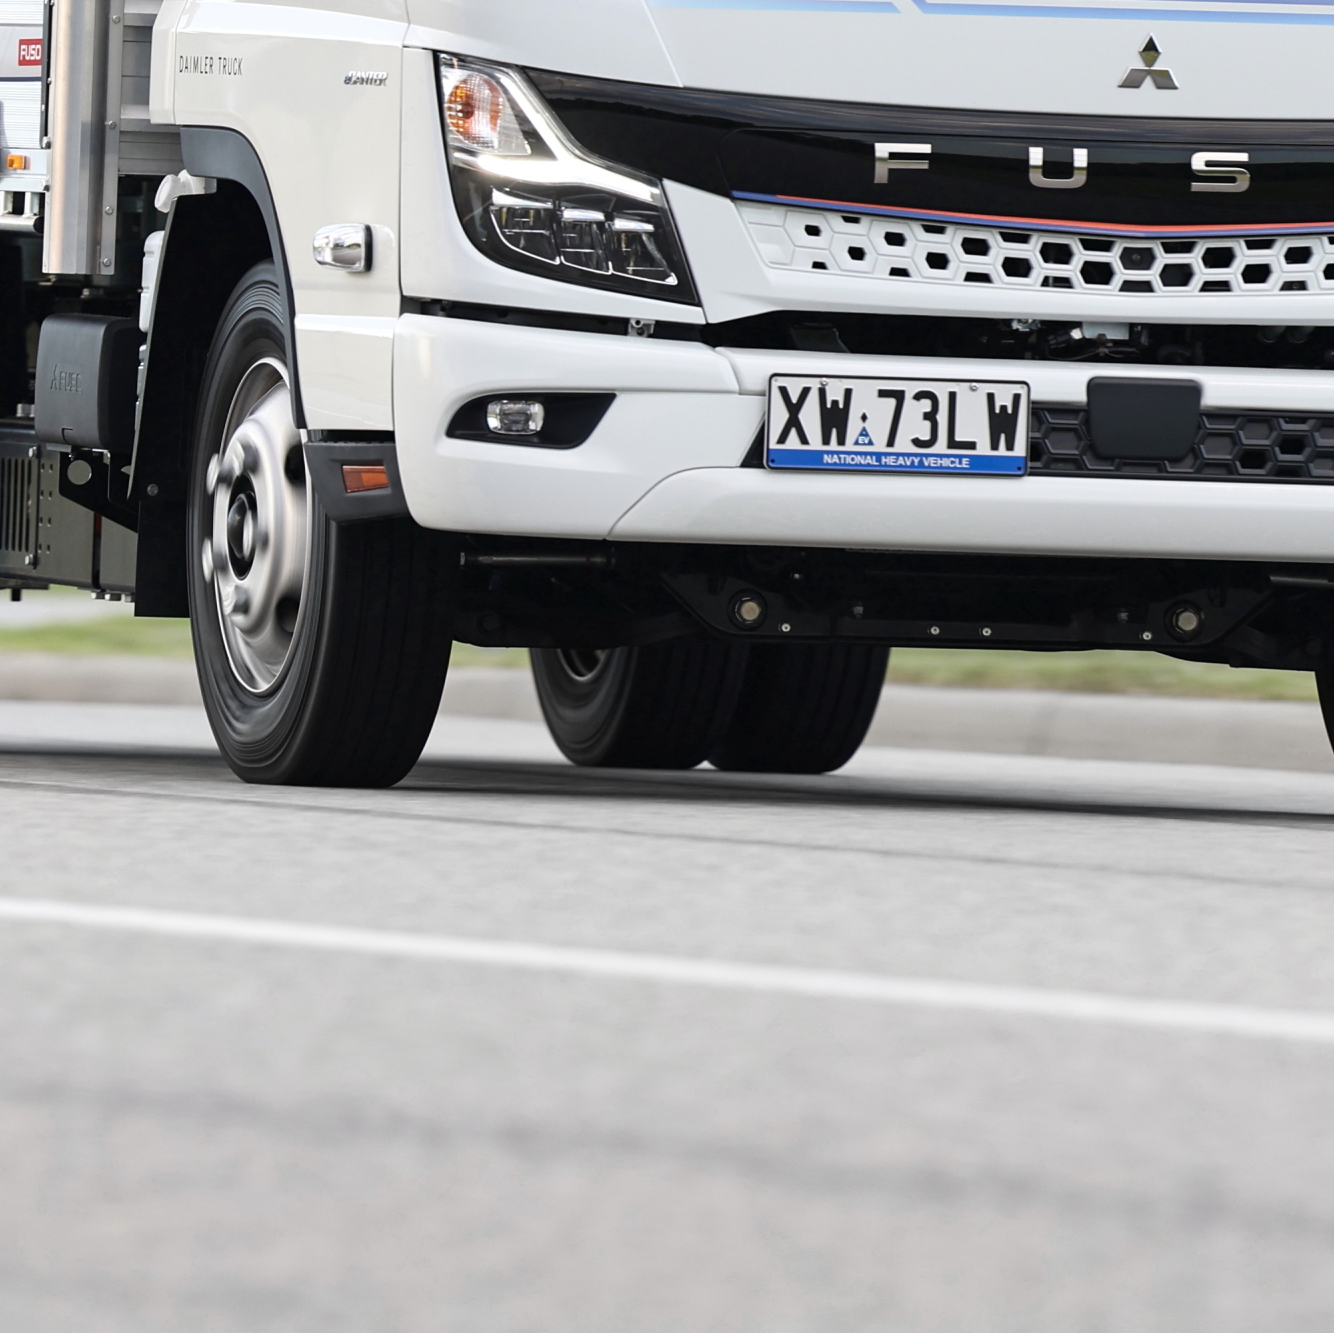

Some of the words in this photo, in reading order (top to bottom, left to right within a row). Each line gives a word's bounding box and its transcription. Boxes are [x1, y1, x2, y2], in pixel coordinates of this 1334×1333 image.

[20, 45, 41, 61] FUSO
[179, 55, 214, 74] DAIMLER
[218, 56, 243, 76] TRUCK
[823, 454, 879, 466] NATIONAL
[881, 456, 920, 467] HEAVY
[922, 457, 970, 468] VEHICLE
